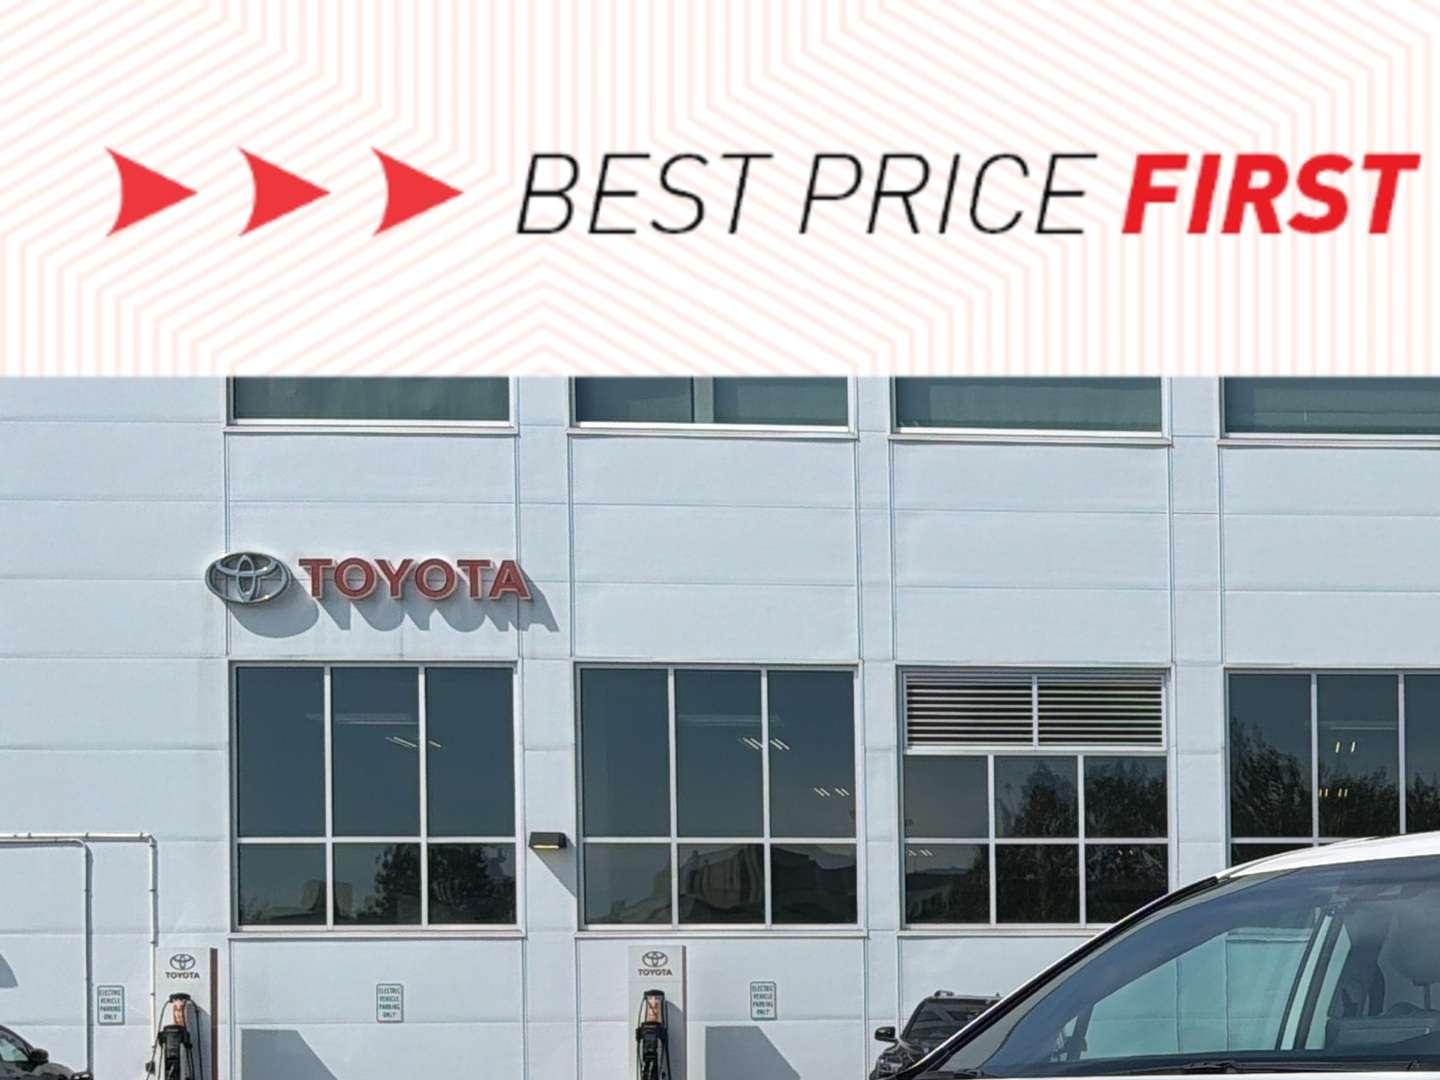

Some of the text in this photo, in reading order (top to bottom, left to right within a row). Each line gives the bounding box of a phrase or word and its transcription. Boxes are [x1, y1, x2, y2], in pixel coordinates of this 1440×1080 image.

[299, 557, 531, 601] TOYOTA
[165, 971, 200, 980] TOYOTA
[638, 968, 673, 977] TOYOTA
